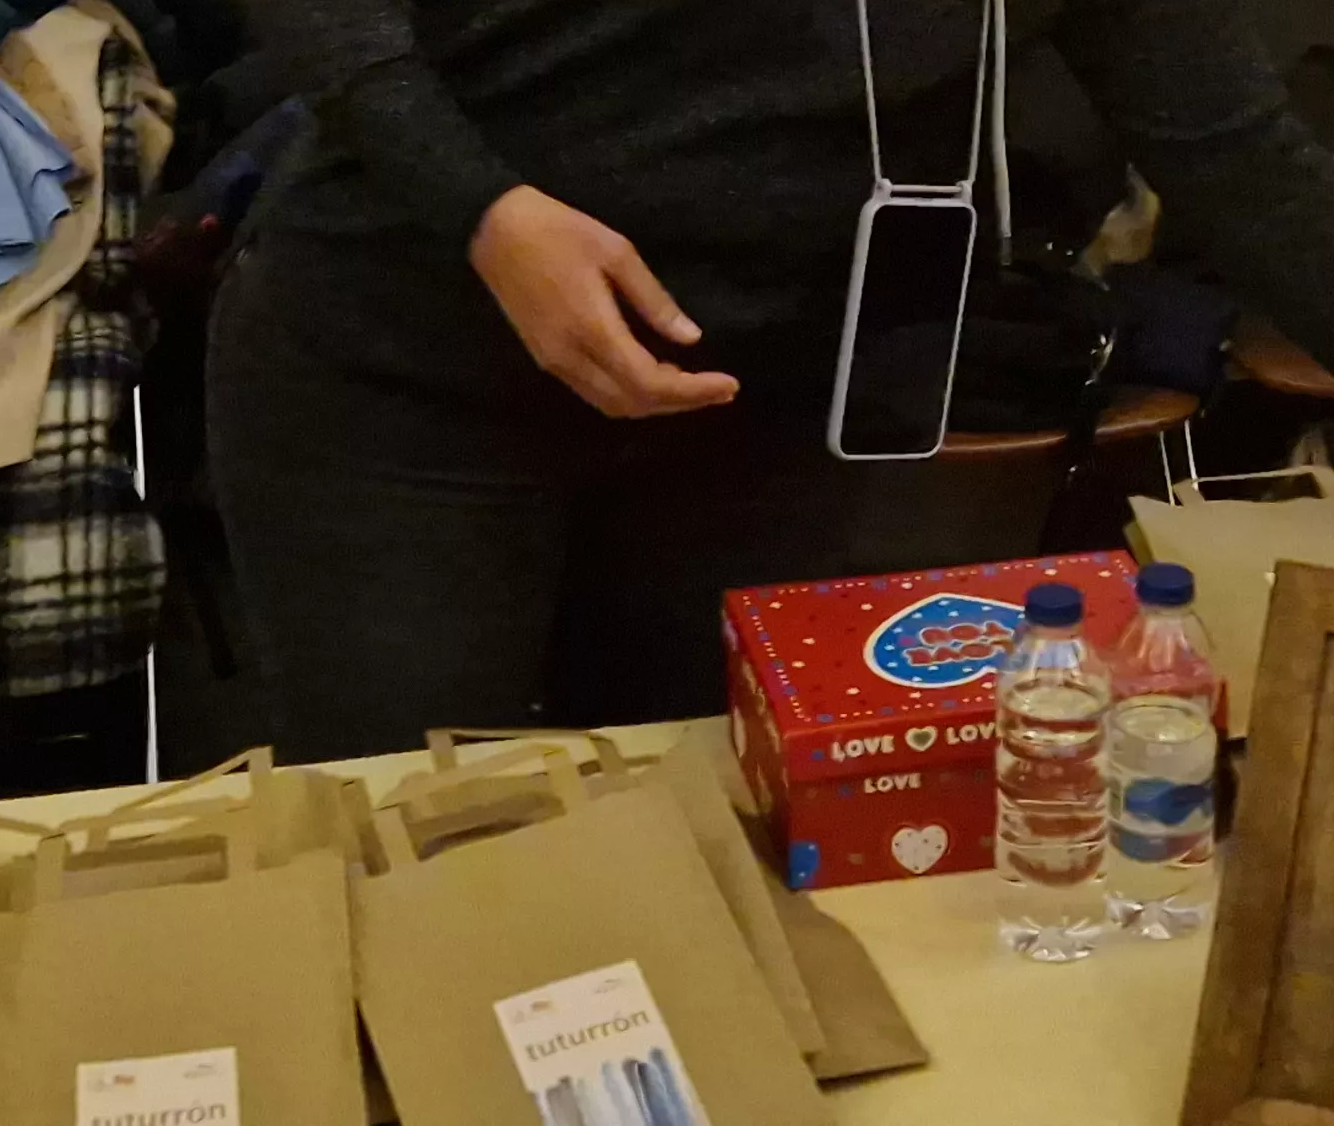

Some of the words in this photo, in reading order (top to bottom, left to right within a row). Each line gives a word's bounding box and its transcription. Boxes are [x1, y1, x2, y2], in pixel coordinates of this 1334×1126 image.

[831, 735, 895, 763] LOVE
[863, 773, 921, 794] LOVE
[525, 1008, 650, 1061] tuturrón
